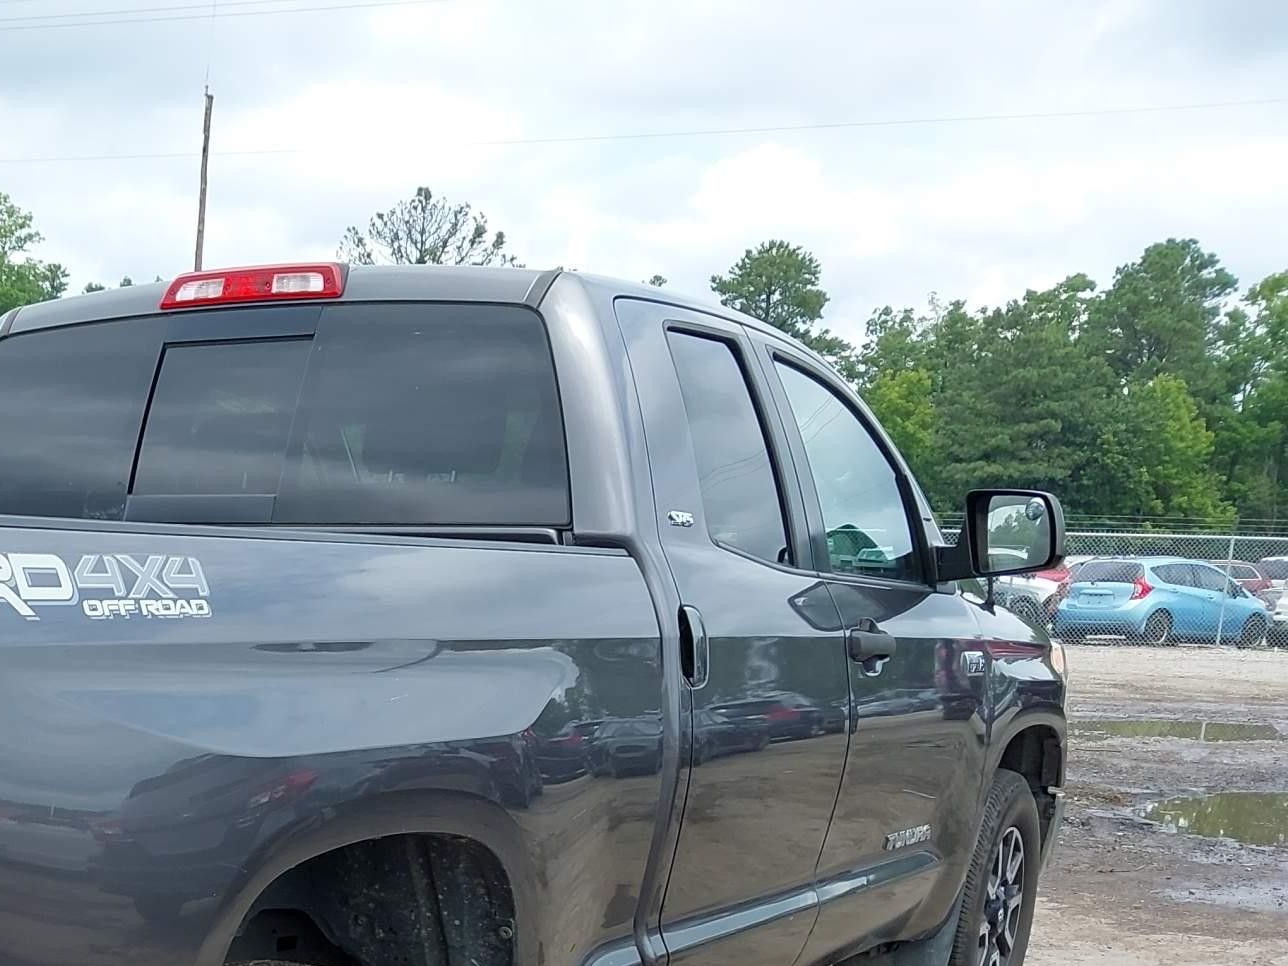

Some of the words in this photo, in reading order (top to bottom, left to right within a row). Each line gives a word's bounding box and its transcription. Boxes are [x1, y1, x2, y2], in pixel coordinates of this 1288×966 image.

[74, 554, 210, 599] 4X4
[82, 598, 138, 620] OFF
[141, 598, 213, 620] ROAD
[886, 823, 932, 851] TUNDRA
